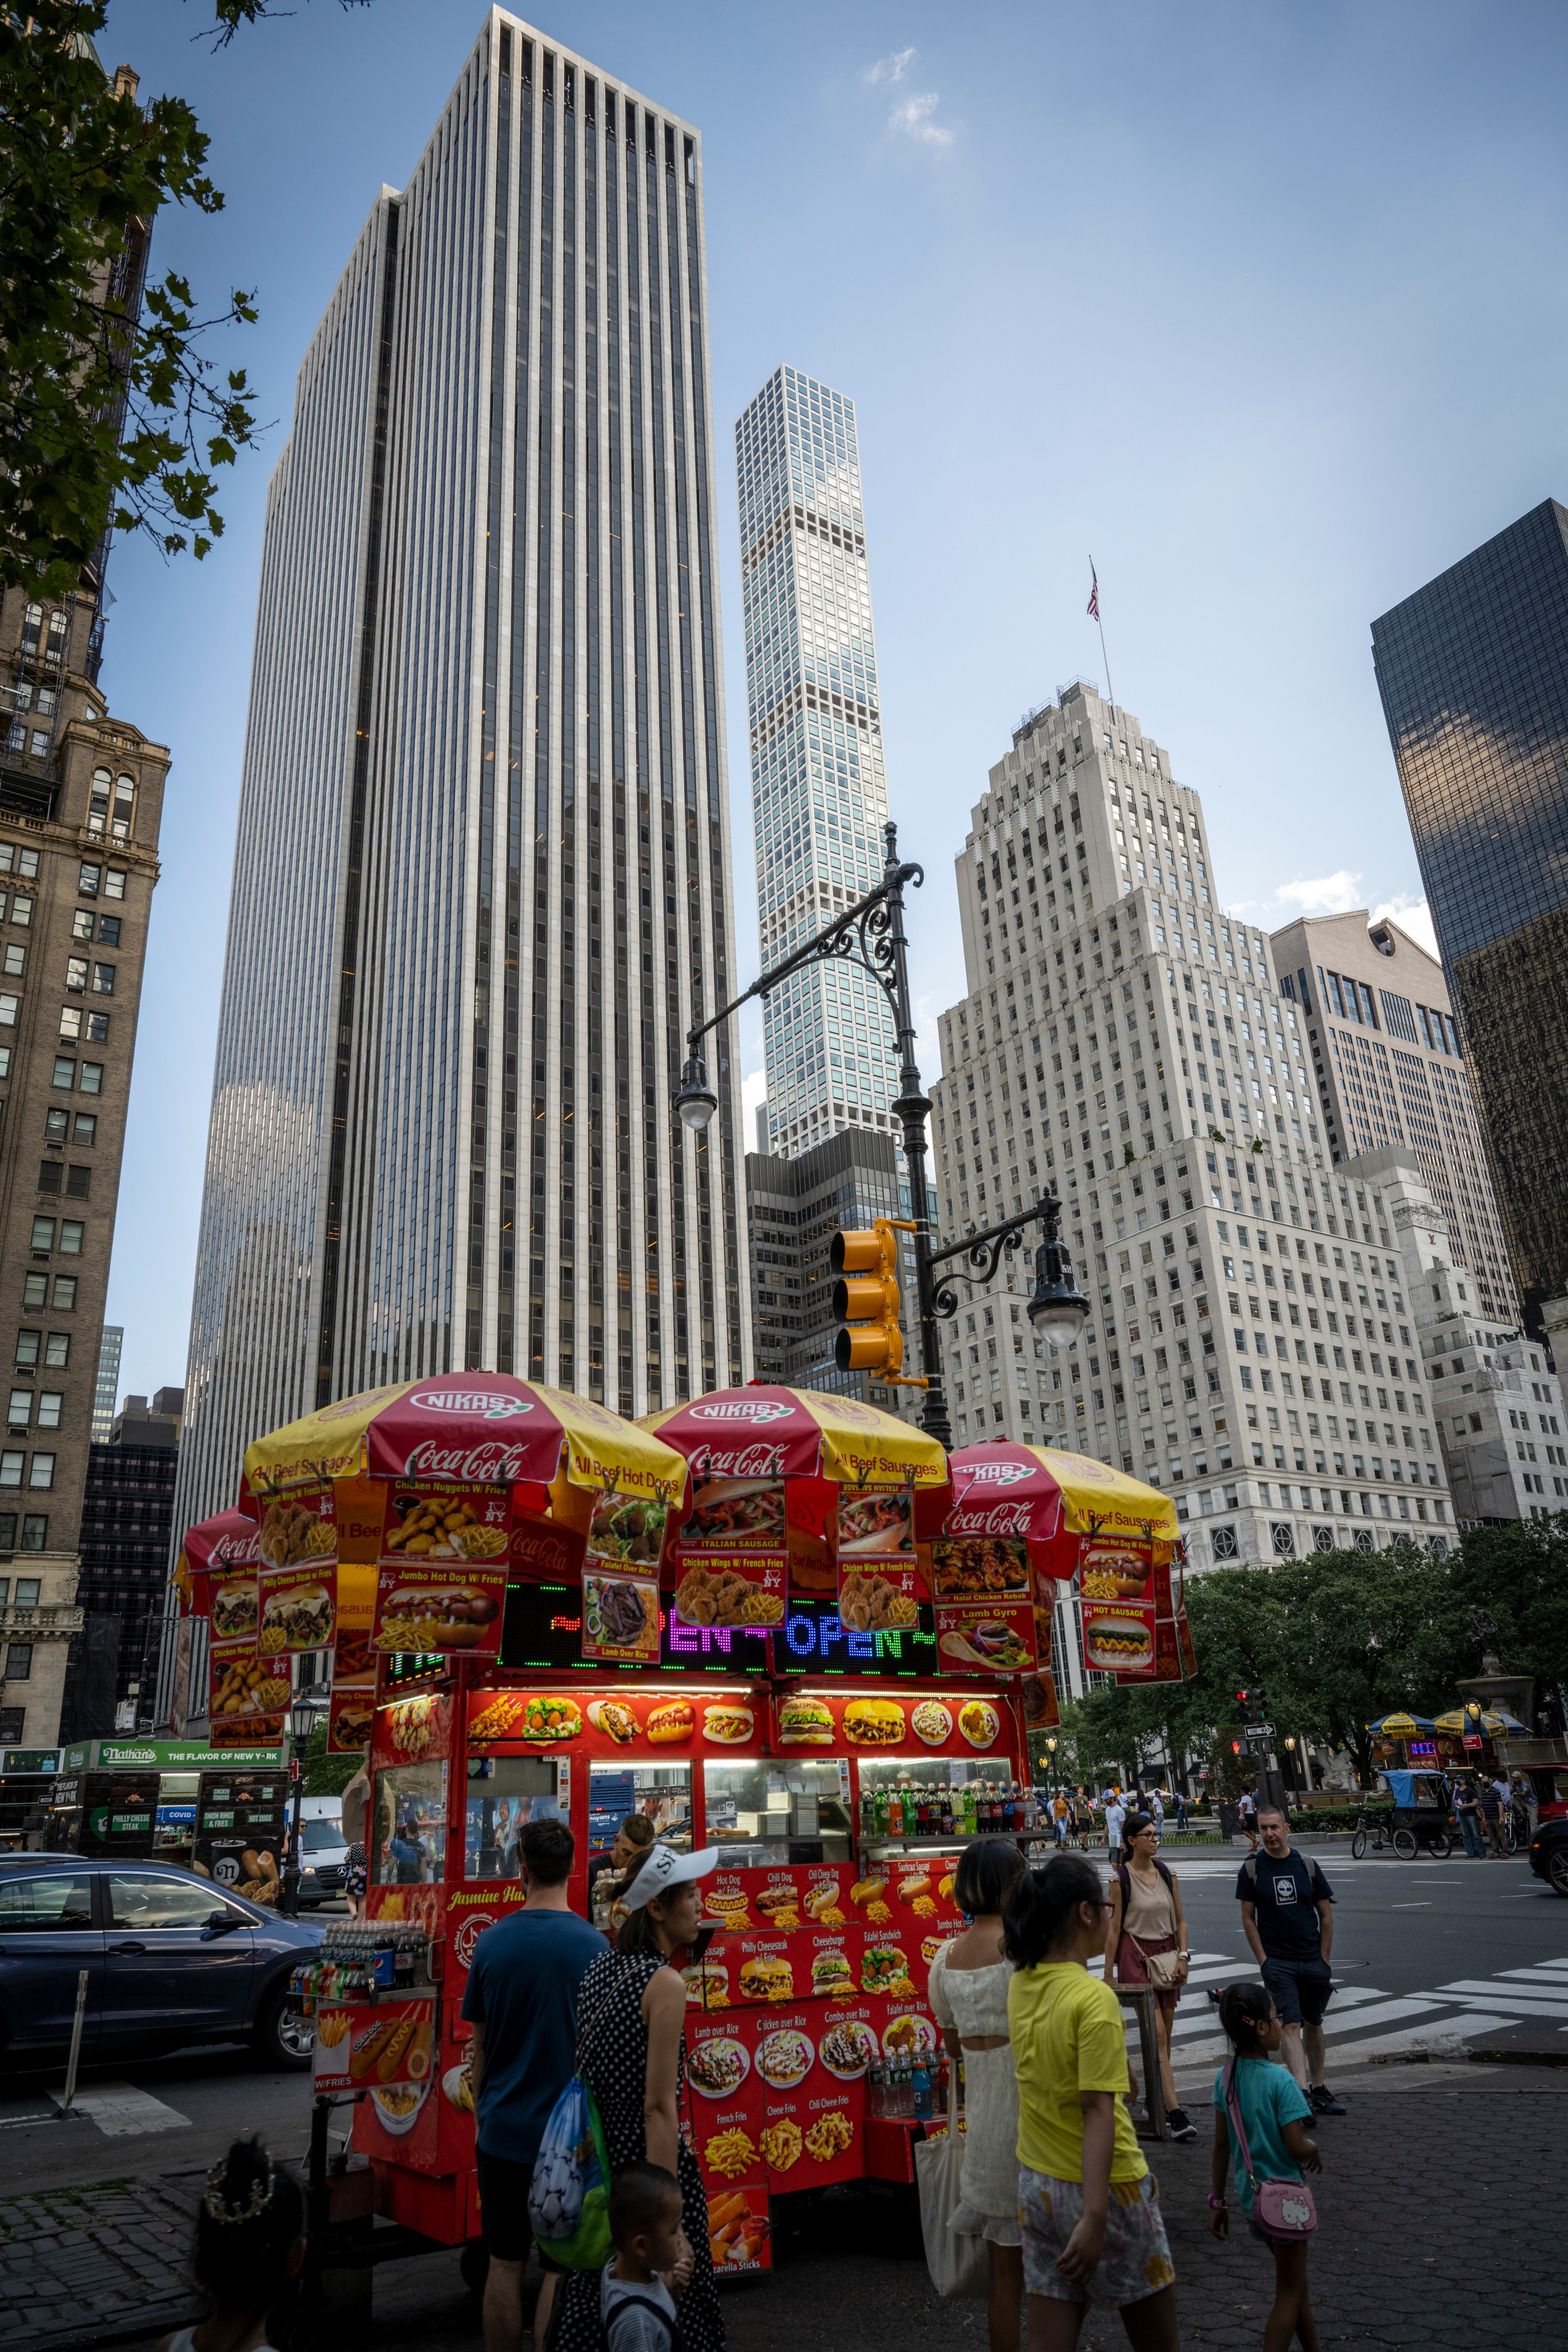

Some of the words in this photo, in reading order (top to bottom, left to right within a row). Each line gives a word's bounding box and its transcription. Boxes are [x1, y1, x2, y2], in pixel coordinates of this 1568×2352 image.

[428, 1394, 506, 1409] NIKAS
[704, 1404, 771, 1417] NIKAS
[404, 1440, 530, 1479] Coca-Cola
[687, 1443, 791, 1475] Coca-Cola
[273, 1460, 299, 1479] Beef
[301, 1456, 353, 1476] Sausages
[835, 1453, 847, 1467] All
[850, 1455, 877, 1470] Beef
[880, 1457, 938, 1478] Sausages
[575, 1457, 590, 1474] All
[594, 1460, 620, 1480] Beef
[624, 1468, 643, 1486] Hot
[647, 1472, 679, 1494] Dogs
[395, 1480, 431, 1490] Chicken
[433, 1482, 470, 1493] Nuggets
[485, 1486, 507, 1494] Fries
[262, 1492, 281, 1506] Chicken
[282, 1490, 296, 1501] Wings
[304, 1486, 320, 1498] French
[321, 1483, 333, 1494] Fries
[485, 1510, 507, 1521] NY
[942, 1501, 1035, 1534] Coca-Cola
[1074, 1508, 1085, 1521] All
[1088, 1509, 1112, 1525] Beef
[1115, 1512, 1170, 1531] Sausages
[1121, 1540, 1130, 1549] Dog
[600, 1560, 622, 1574] Falafel
[623, 1563, 638, 1573] Over
[638, 1566, 652, 1575] Rice
[682, 1558, 709, 1567] Chicken
[711, 1558, 731, 1568] Wings
[743, 1558, 765, 1567] French
[767, 1558, 783, 1567] Fries
[843, 1563, 862, 1572] Chicken
[864, 1564, 879, 1573] Wings
[209, 1572, 225, 1581] Philly
[263, 1577, 276, 1588] Philly
[277, 1575, 295, 1586] Cheese
[296, 1572, 311, 1583] Steak
[319, 1570, 331, 1578] Fries
[399, 1571, 428, 1580] Jumbo
[431, 1572, 447, 1581] Hot
[450, 1573, 466, 1584] Dog
[481, 1575, 503, 1584] Fries
[763, 1578, 781, 1587] NY
[902, 1581, 914, 1590] NY
[993, 1608, 1017, 1618] Gyro
[1110, 1608, 1144, 1617] SAUSAGE
[938, 1620, 957, 1629] NY
[787, 1615, 902, 1657] OPEN
[214, 1648, 236, 1658] Chicken
[601, 1647, 619, 1656] Lamb
[620, 1649, 634, 1658] Over
[635, 1650, 649, 1659] Rice
[103, 1747, 156, 1760] Nathan's
[62, 1781, 74, 1790] FLAVOR
[55, 1793, 65, 1804] NEW
[869, 1864, 881, 1874] Cheese
[898, 1863, 915, 1872] Saurkraut
[916, 1862, 930, 1872] Sausage
[945, 1860, 957, 1869] Cheese
[717, 1876, 727, 1885] Hot
[729, 1875, 741, 1885] Dog
[767, 1872, 780, 1882] Chili
[781, 1873, 792, 1883] Dog
[809, 1869, 817, 1879] Chili
[818, 1869, 830, 1879] Cheese
[831, 1869, 839, 1880] Dog
[727, 1887, 739, 1895] Fries
[821, 1881, 834, 1890] Fries
[447, 1889, 500, 1911] Jasmine
[459, 1912, 492, 1929] Certification
[937, 1920, 952, 1931] Jumbo
[953, 1919, 962, 1928] Hot
[813, 1936, 845, 1947] Cheeseburger
[864, 1931, 878, 1942] Falafel
[880, 1931, 902, 1940] Sandwich
[742, 1942, 756, 1953] Philly
[757, 1940, 788, 1951] Cheesesteak
[827, 1947, 840, 1957] Fries
[881, 1943, 893, 1951] Fries
[764, 1954, 777, 1962] Fries
[887, 2004, 903, 2015] Falafel
[904, 2005, 915, 2013] over
[916, 2002, 927, 2011] Rice
[824, 2011, 845, 2022] Combo
[846, 2011, 857, 2019] over
[859, 2008, 870, 2018] Rice
[757, 2019, 779, 2030] Chicken
[780, 2019, 793, 2028] over
[794, 2016, 807, 2026] Rice
[353, 2034, 371, 2051] CORN
[366, 2020, 382, 2038] DOG
[695, 2027, 710, 2038] Lamb
[712, 2027, 725, 2036] over
[726, 2024, 739, 2034] Rice
[315, 2076, 352, 2089] W/FRIES
[809, 2099, 820, 2110] Chili
[821, 2097, 837, 2108] Cheese
[839, 2095, 850, 2105] Fries
[914, 2092, 921, 2103] G
[767, 2106, 783, 2116] Cheese
[785, 2103, 796, 2113] Fries
[717, 2114, 734, 2124] French
[735, 2112, 747, 2122] Fries
[739, 2260, 760, 2271] Sticks
